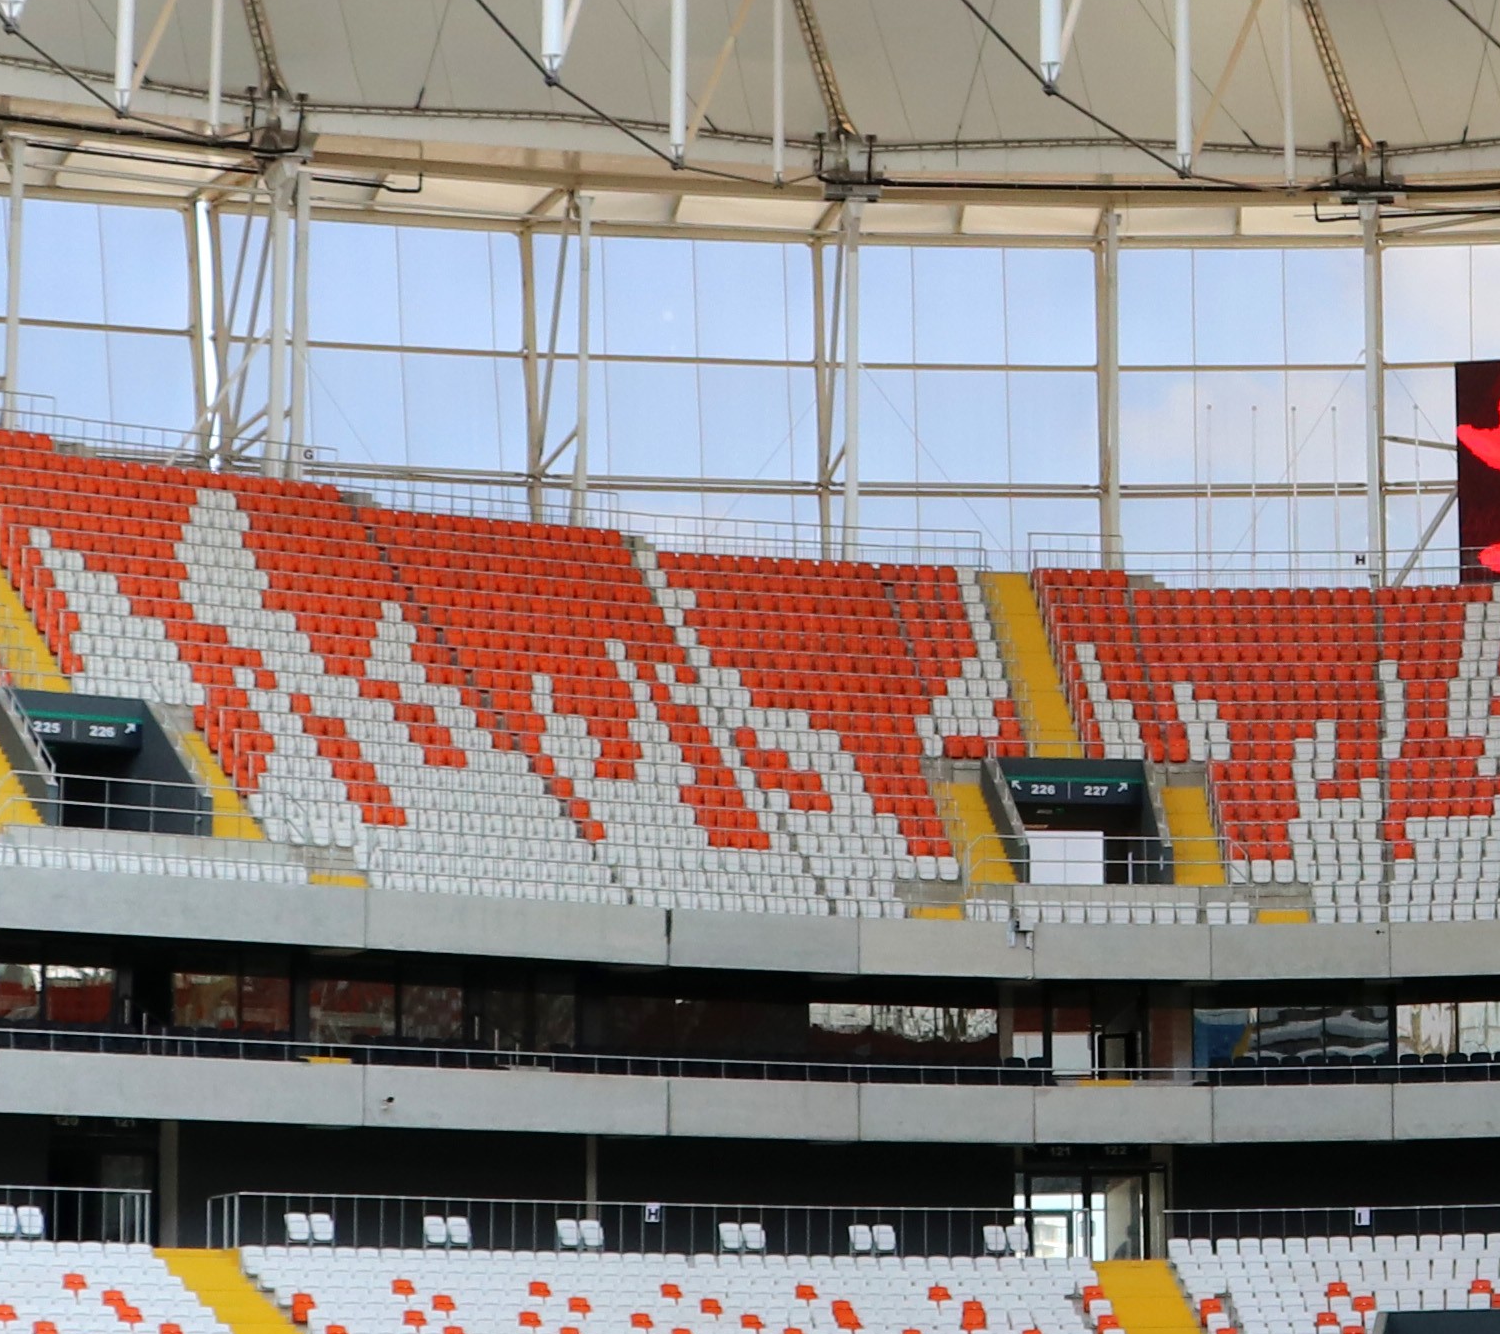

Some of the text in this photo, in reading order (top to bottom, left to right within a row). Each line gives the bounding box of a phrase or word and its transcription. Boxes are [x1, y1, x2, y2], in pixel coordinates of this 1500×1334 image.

[303, 449, 314, 460] G
[1355, 554, 1366, 565] H
[33, 721, 116, 738] 225 226
[1030, 784, 1109, 797] 226 227
[647, 1208, 659, 1220] H
